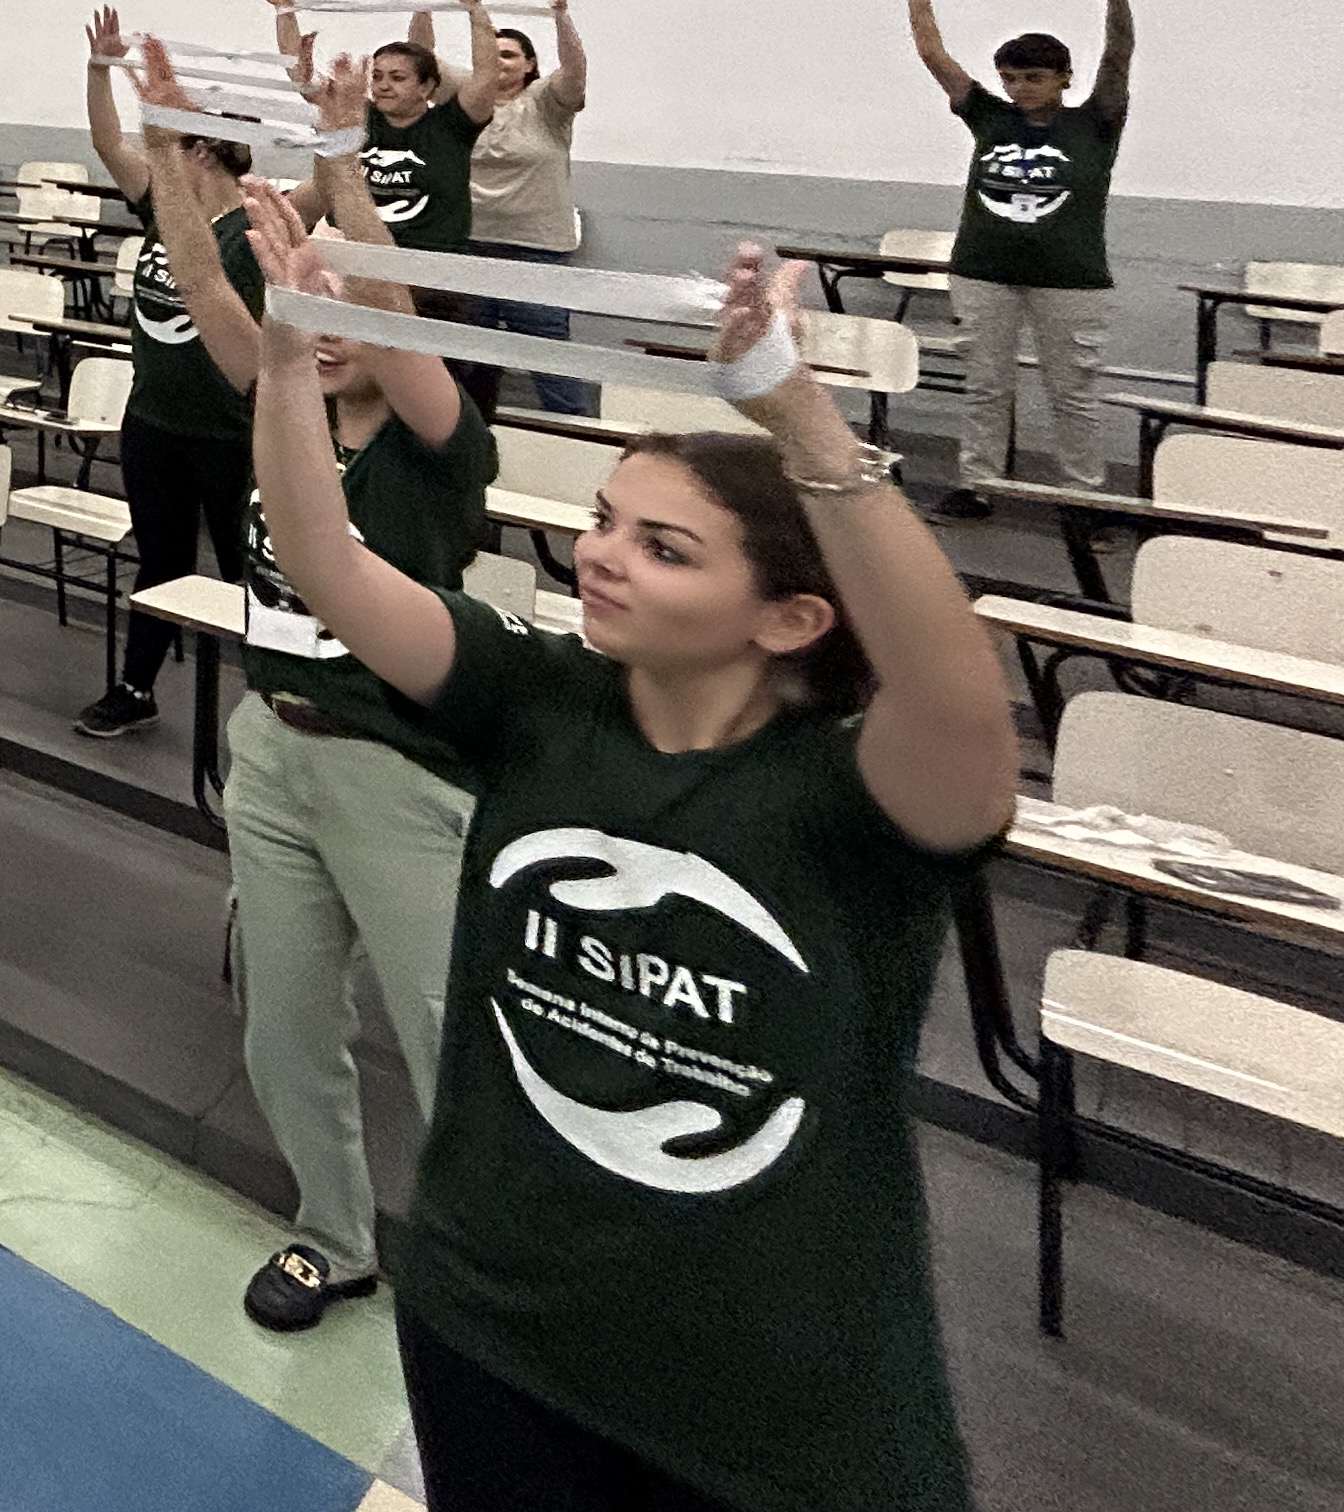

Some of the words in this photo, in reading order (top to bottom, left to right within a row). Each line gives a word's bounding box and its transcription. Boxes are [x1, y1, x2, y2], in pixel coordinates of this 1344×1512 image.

[524, 908, 559, 959] II
[578, 934, 747, 1024] SIPAT
[521, 998, 544, 1016] de
[633, 1048, 657, 1068] de
